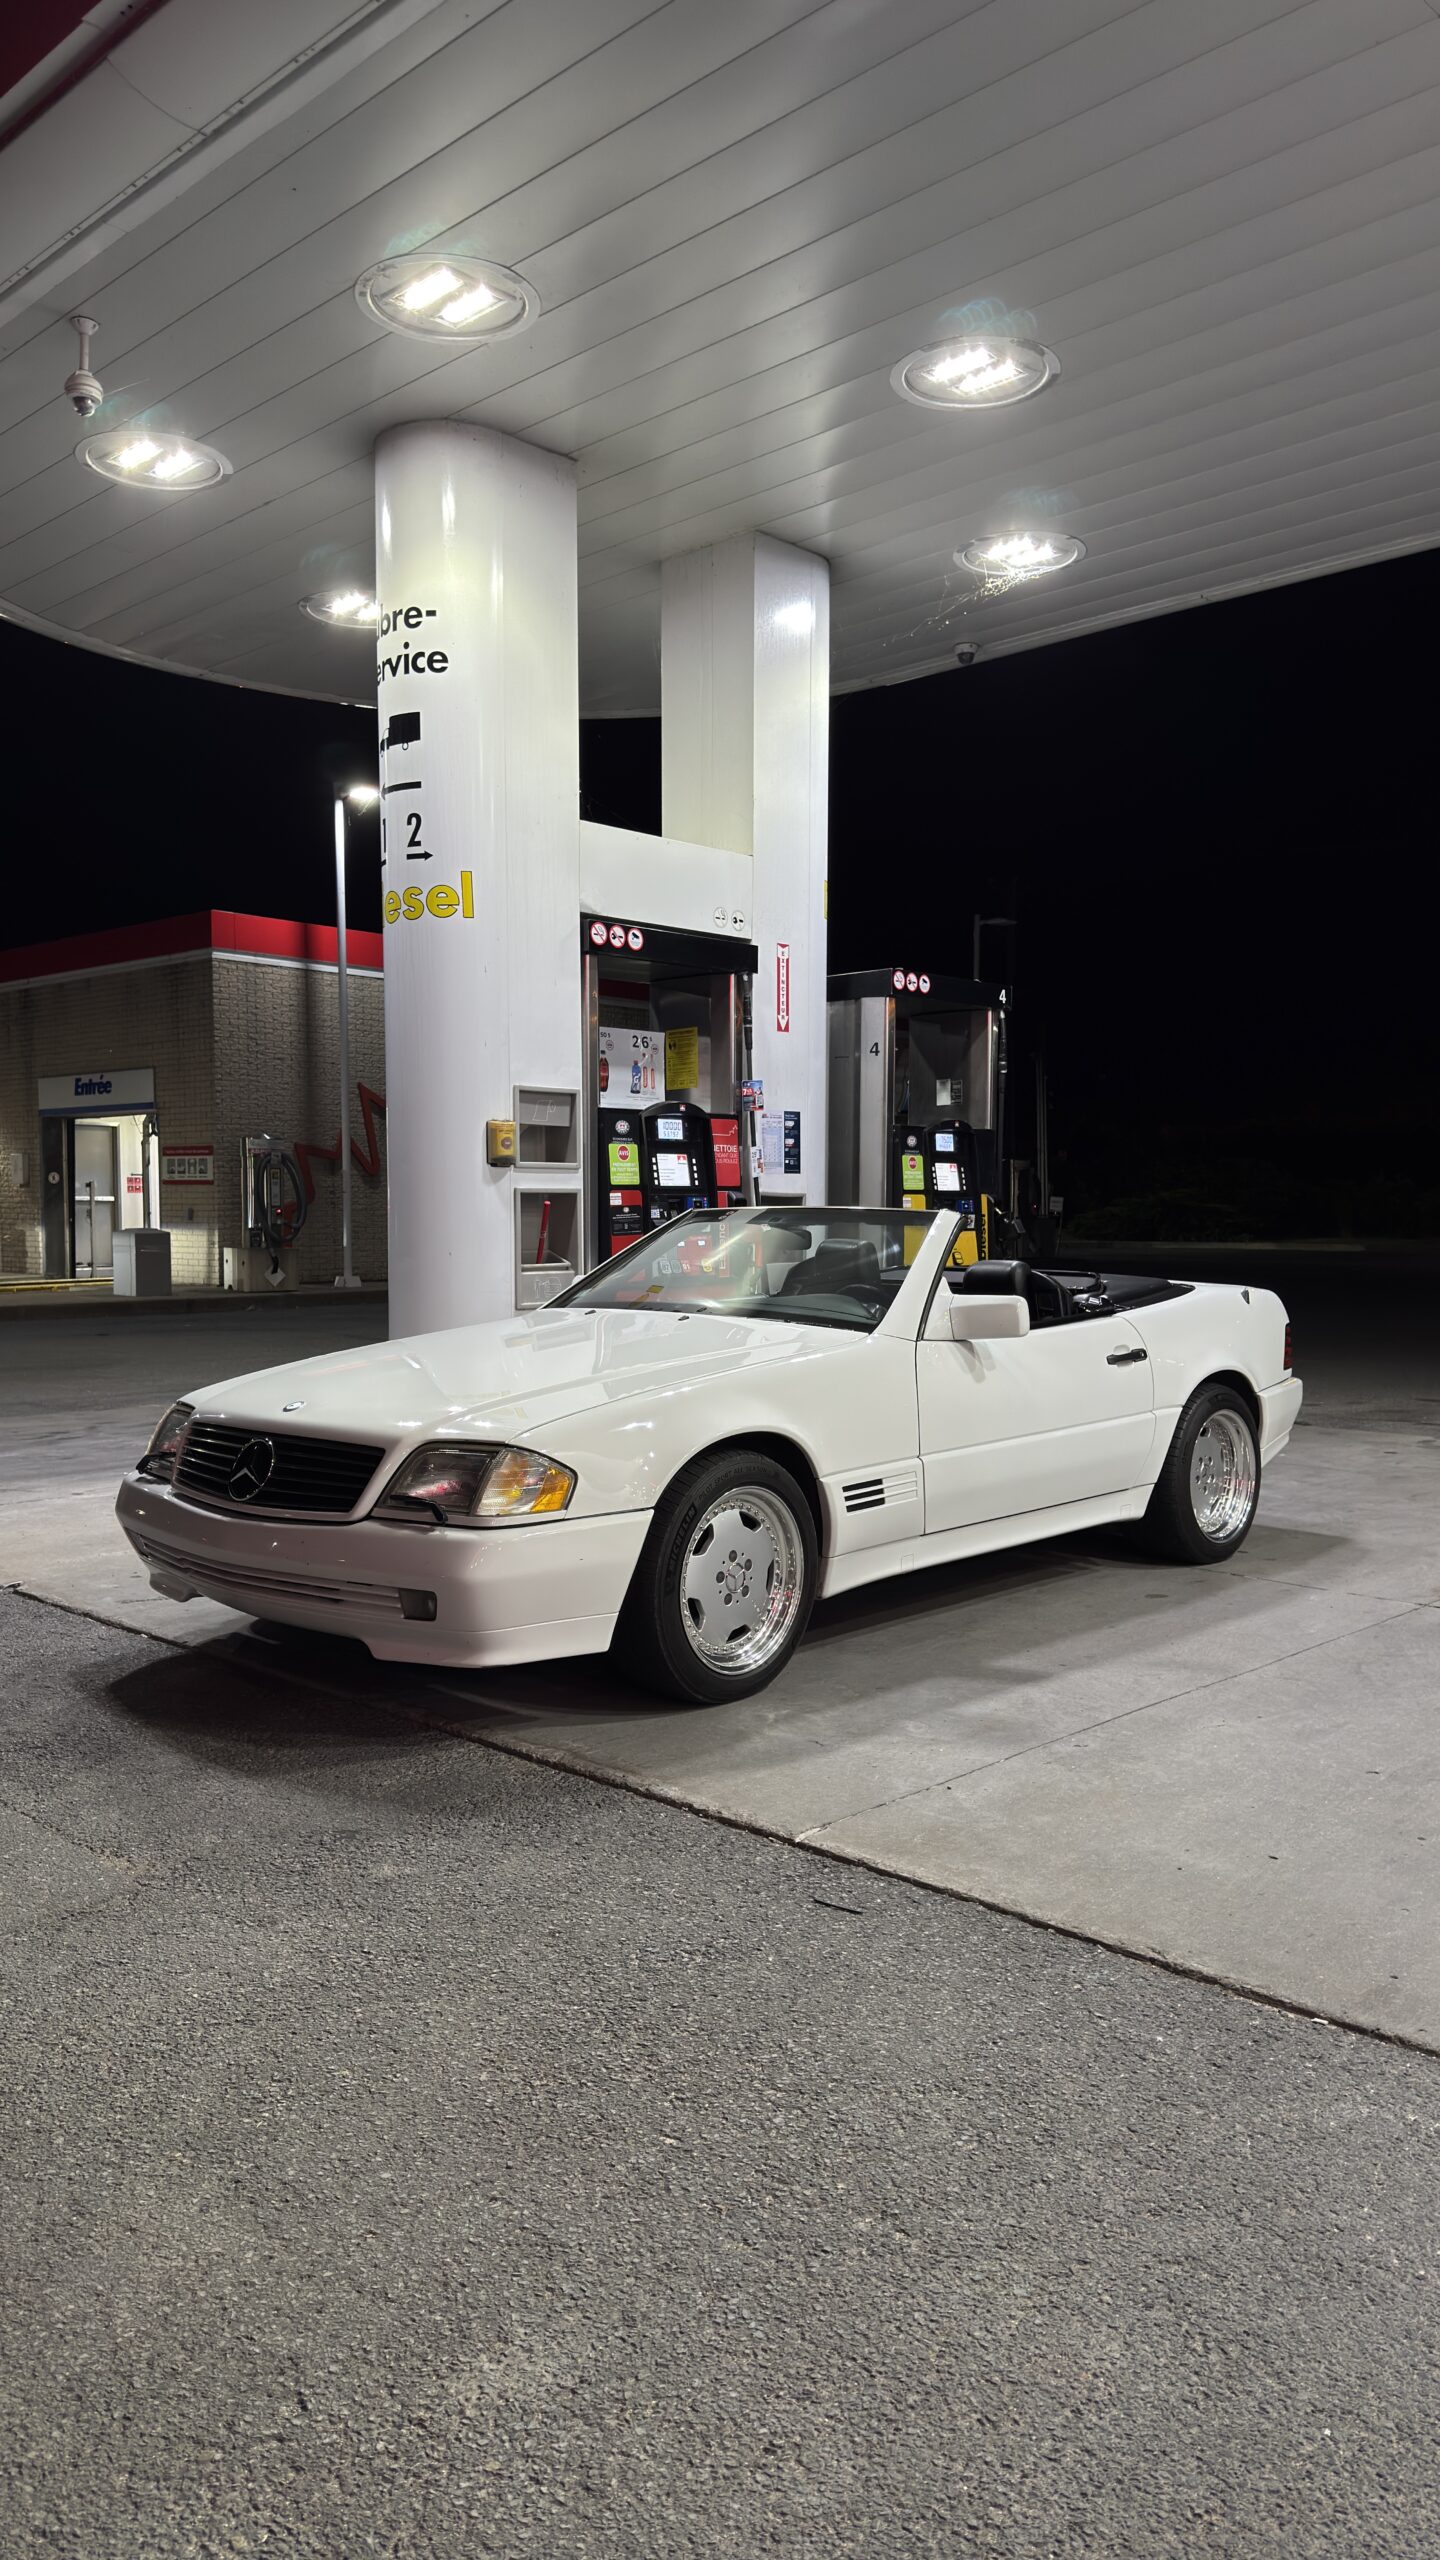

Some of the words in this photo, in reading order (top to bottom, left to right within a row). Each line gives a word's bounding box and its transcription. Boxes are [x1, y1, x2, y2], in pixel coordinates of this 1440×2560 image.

[378, 603, 437, 639] bre-
[377, 641, 449, 687] ervice
[406, 812, 422, 848] 2
[384, 870, 475, 924] esel
[999, 989, 1006, 1004] 4
[869, 1042, 880, 1057] 4
[74, 1074, 112, 1096] Entrée
